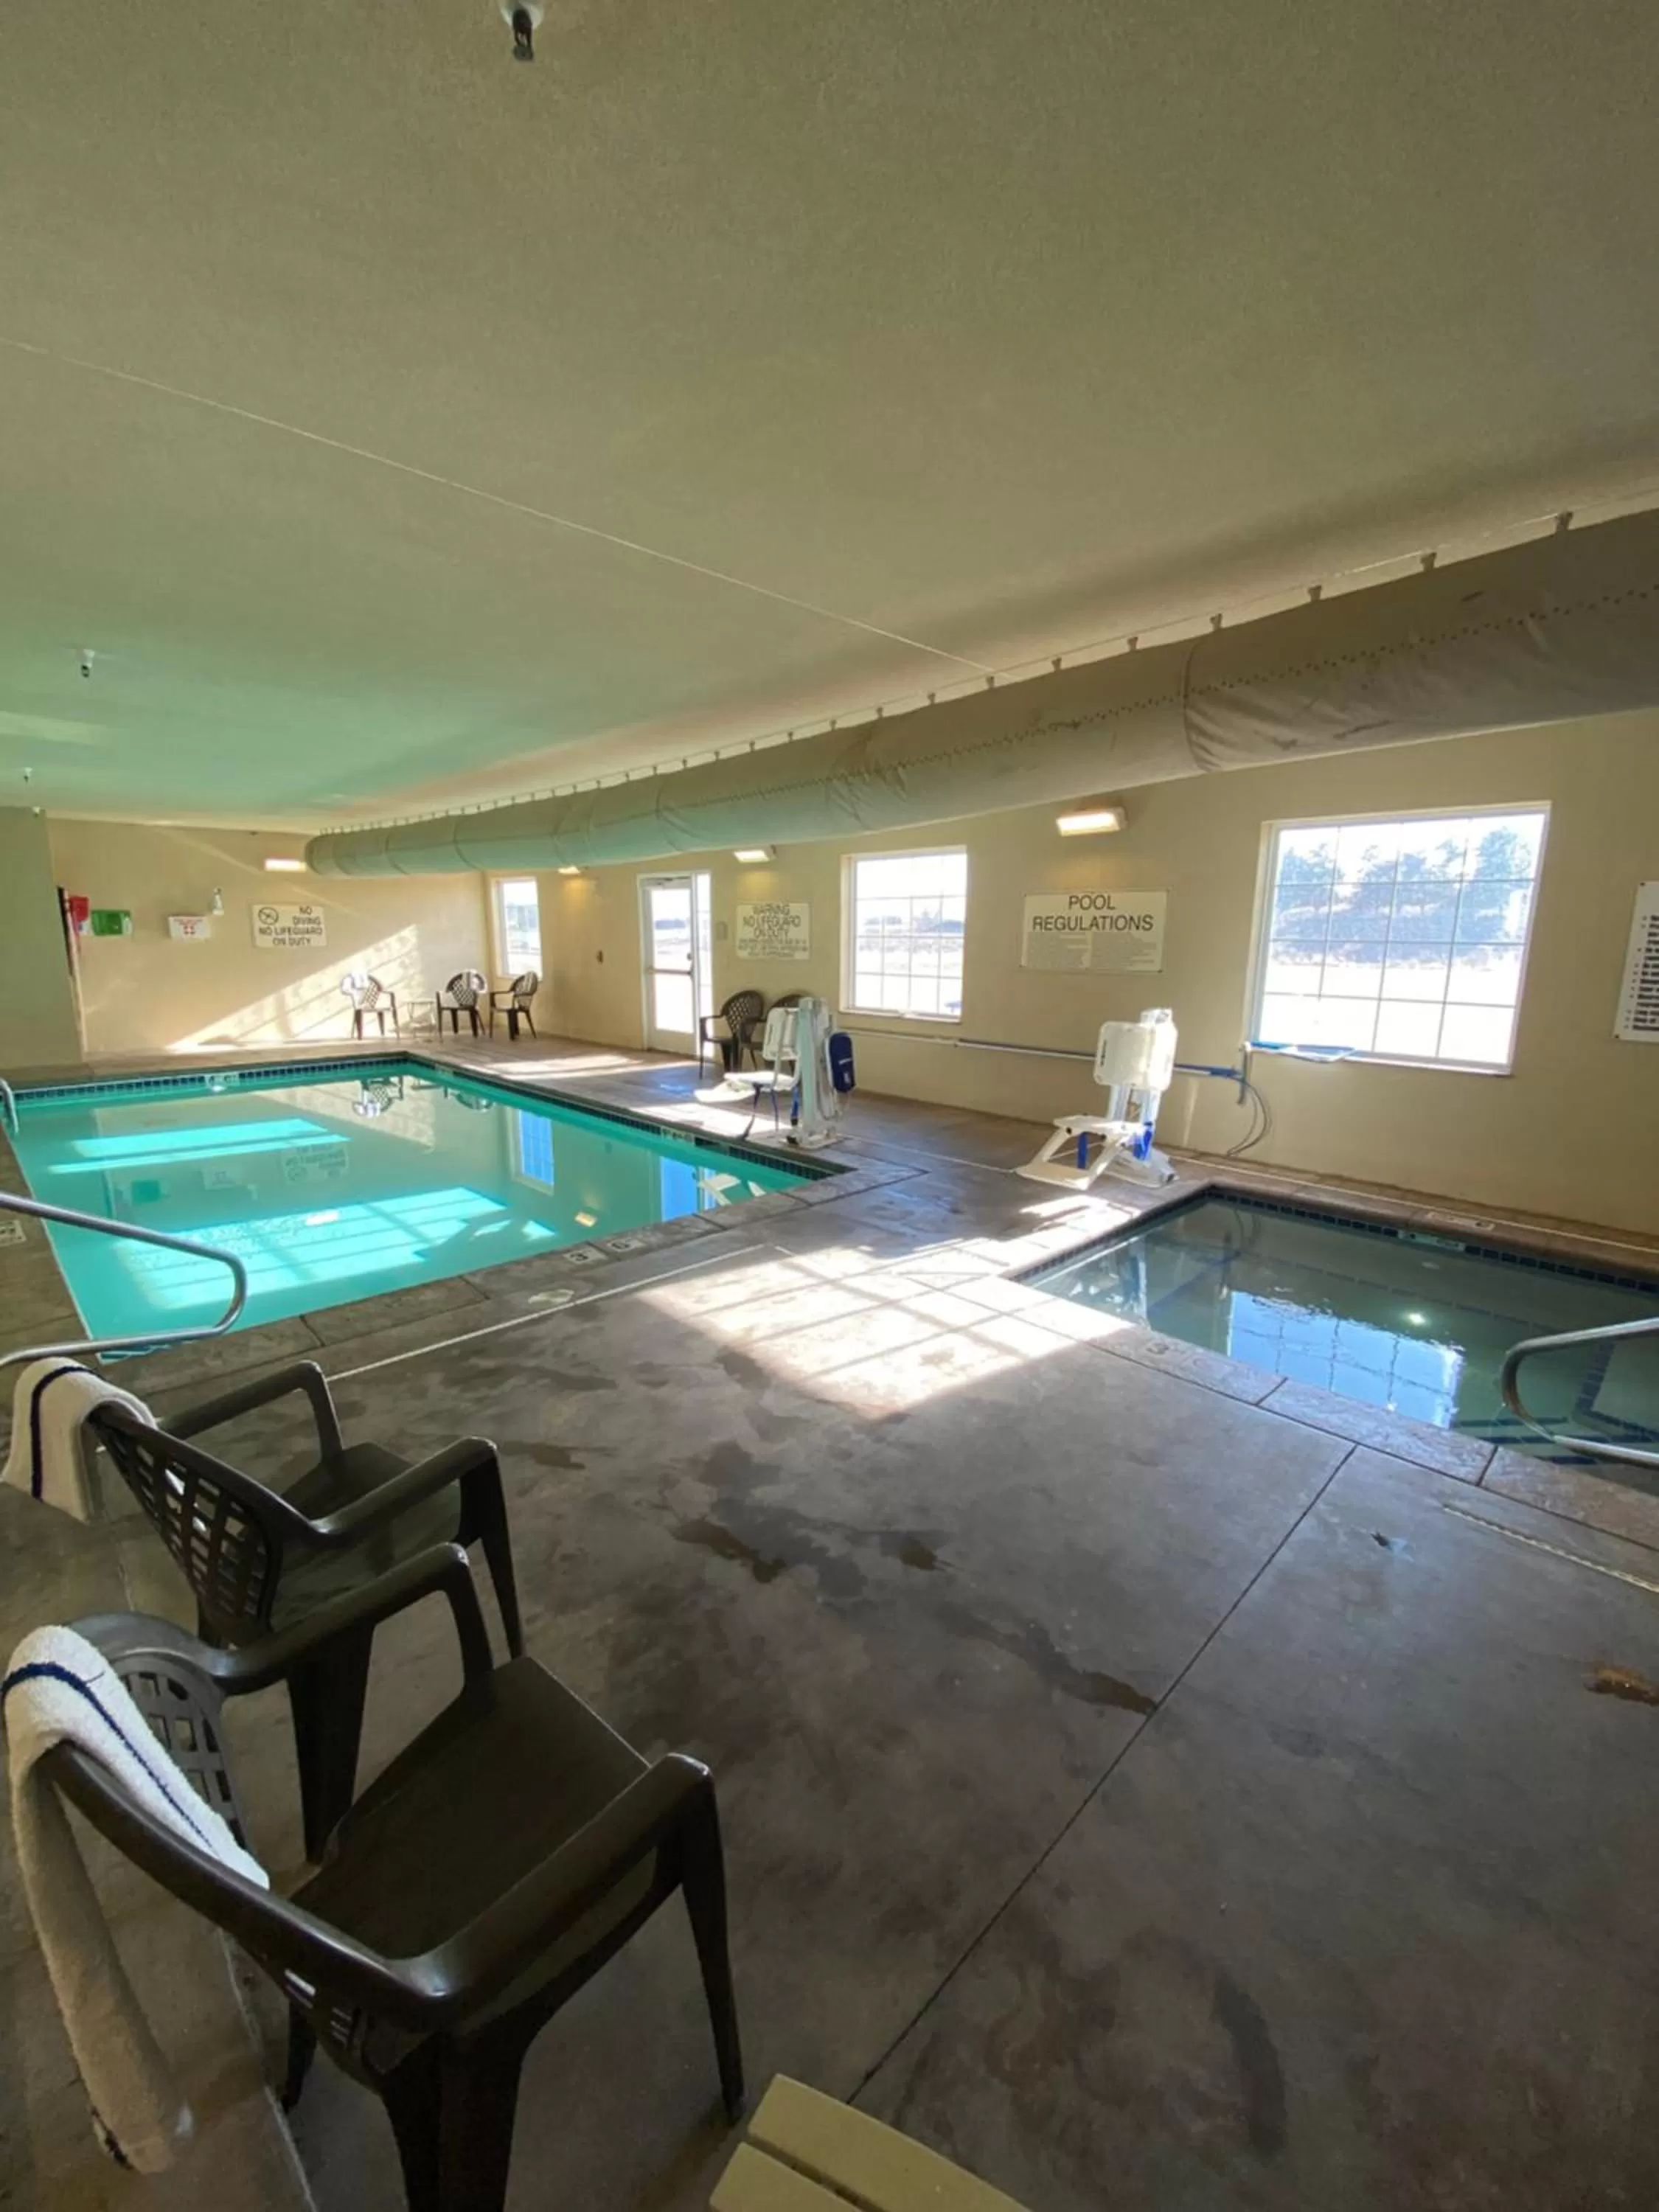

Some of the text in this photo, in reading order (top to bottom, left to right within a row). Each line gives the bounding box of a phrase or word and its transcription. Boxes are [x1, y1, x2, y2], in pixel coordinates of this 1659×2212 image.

[1068, 894, 1116, 911] POOL
[299, 905, 313, 915] NO
[292, 916, 321, 925] DIVING
[742, 916, 755, 928] NO
[1033, 914, 1155, 932] REGULATIONS
[259, 926, 322, 936] NO LIFEGUARD
[272, 937, 310, 946] ON DUTY
